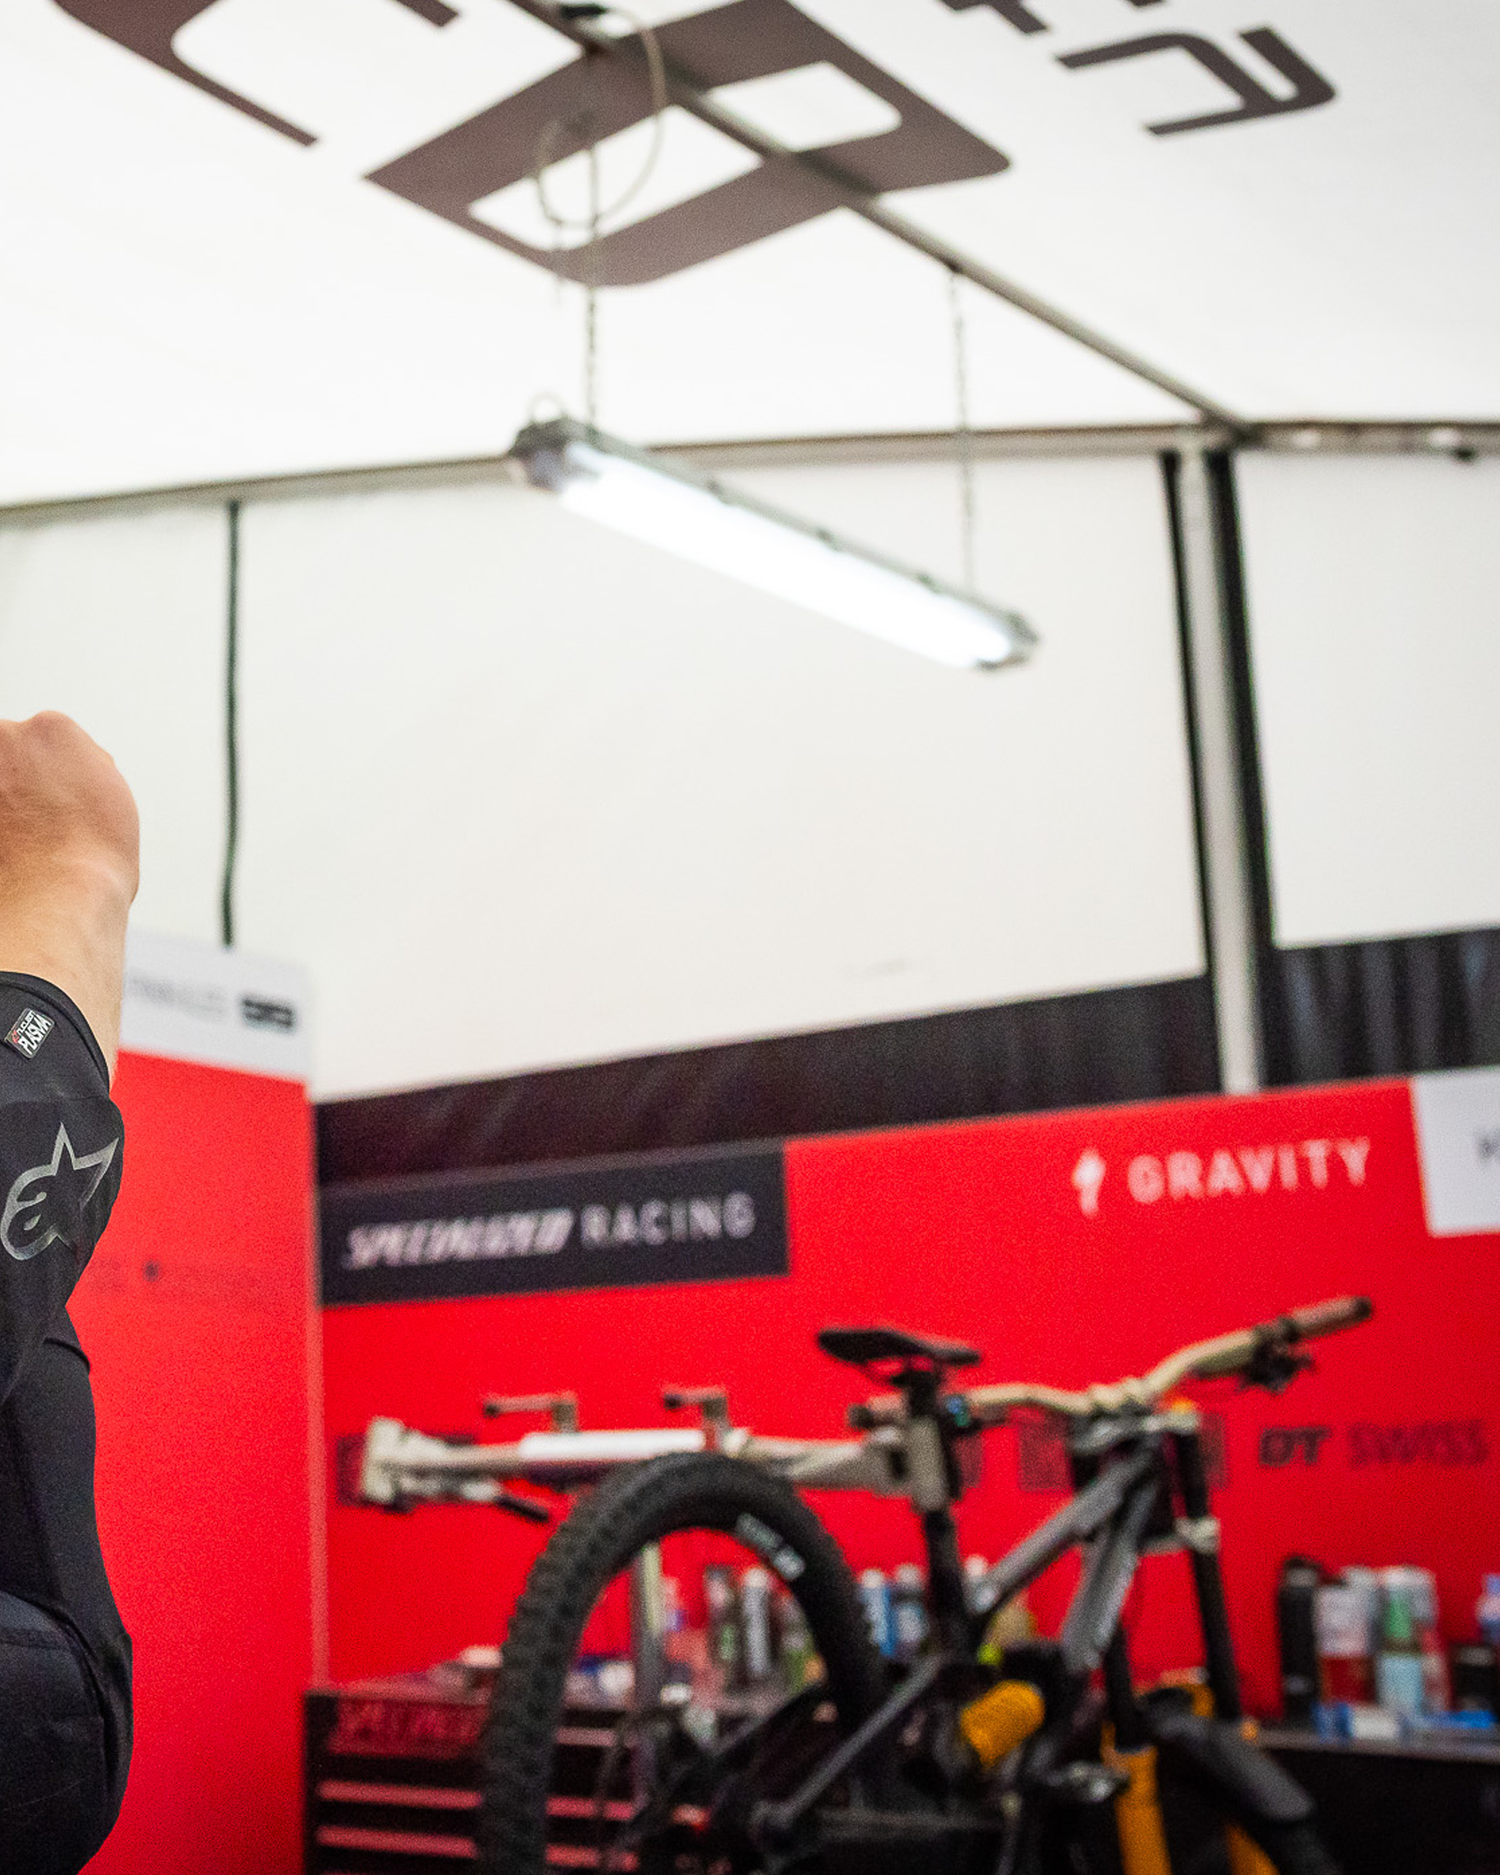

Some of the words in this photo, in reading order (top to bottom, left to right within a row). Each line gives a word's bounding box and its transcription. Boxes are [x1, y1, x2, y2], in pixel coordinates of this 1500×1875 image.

[18, 1013, 52, 1055] PLASMA
[1127, 1136, 1371, 1203] GRAVITY
[580, 1190, 757, 1250] RACING
[1258, 1425, 1333, 1467] DT
[1347, 1420, 1490, 1468] SWISS
